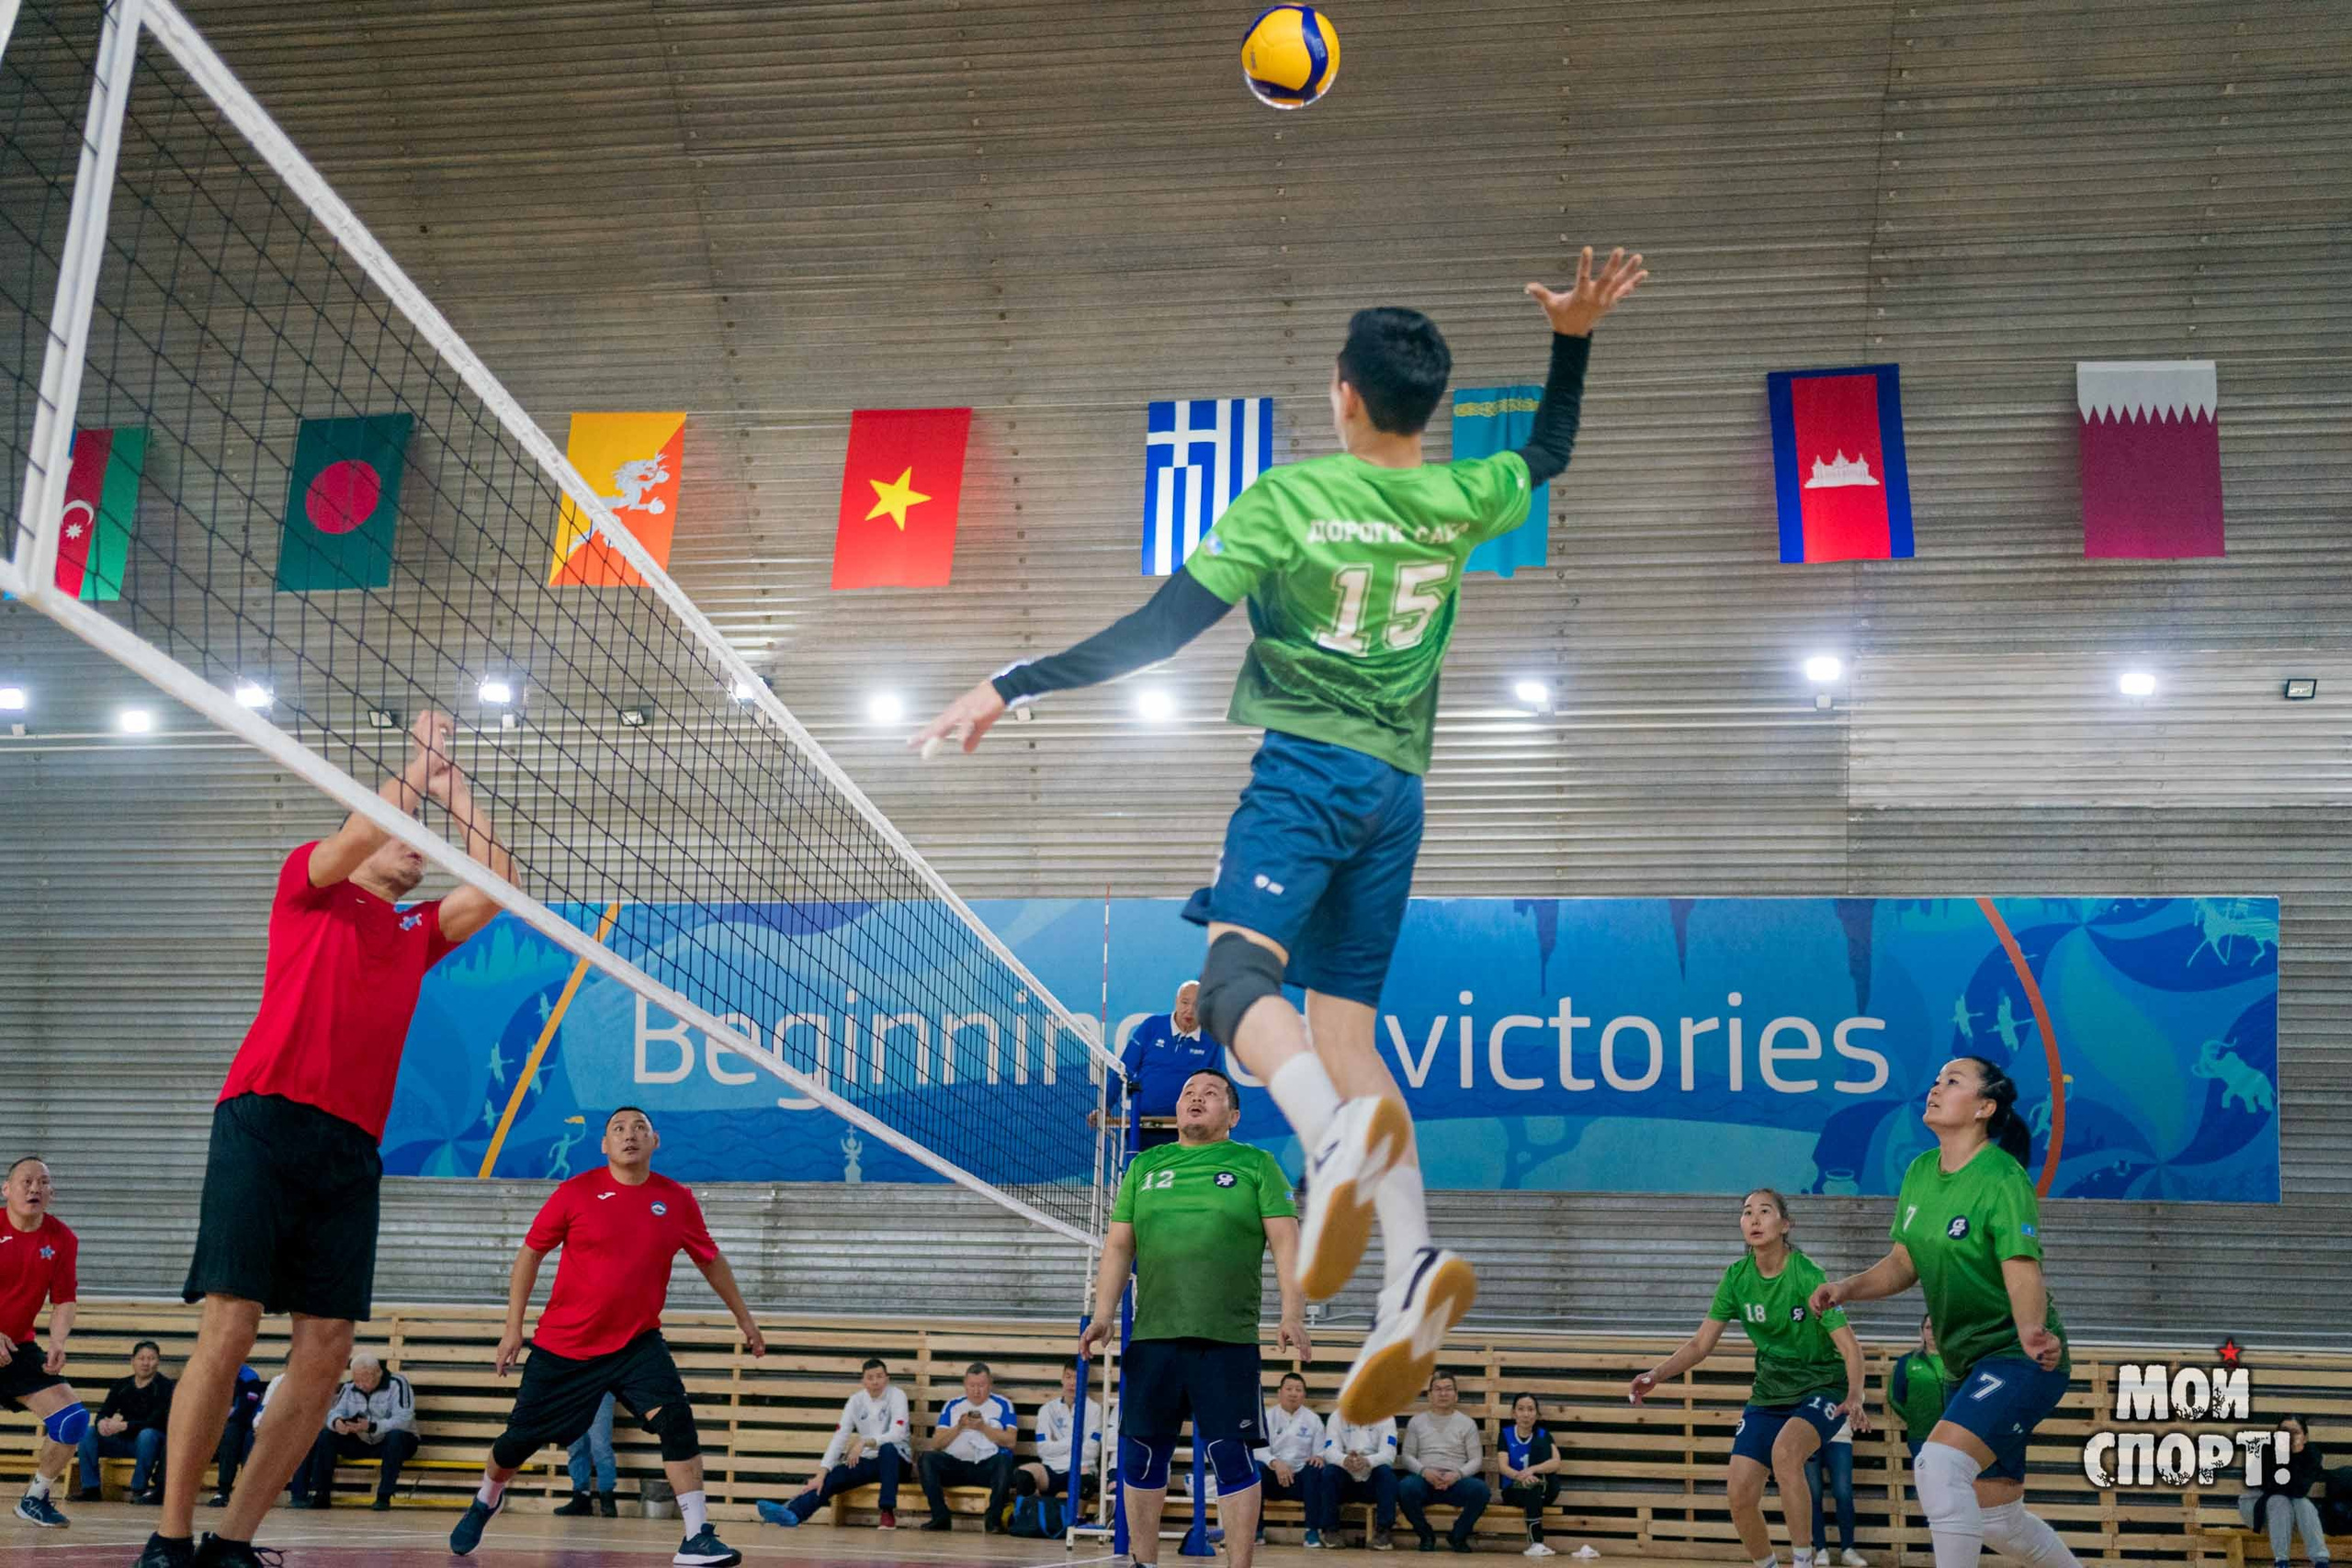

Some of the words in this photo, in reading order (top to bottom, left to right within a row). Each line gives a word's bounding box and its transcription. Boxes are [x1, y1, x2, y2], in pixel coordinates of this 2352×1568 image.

[1306, 518, 1407, 545] ДОРОГИ
[1315, 555, 1455, 659] 15
[1384, 990, 1891, 1094] victories
[1140, 1169, 1176, 1192] 12
[1902, 1204, 1917, 1233] 7
[1745, 1303, 1767, 1324] 18
[1970, 1371, 2007, 1402] 7
[1808, 1395, 1838, 1421] 18
